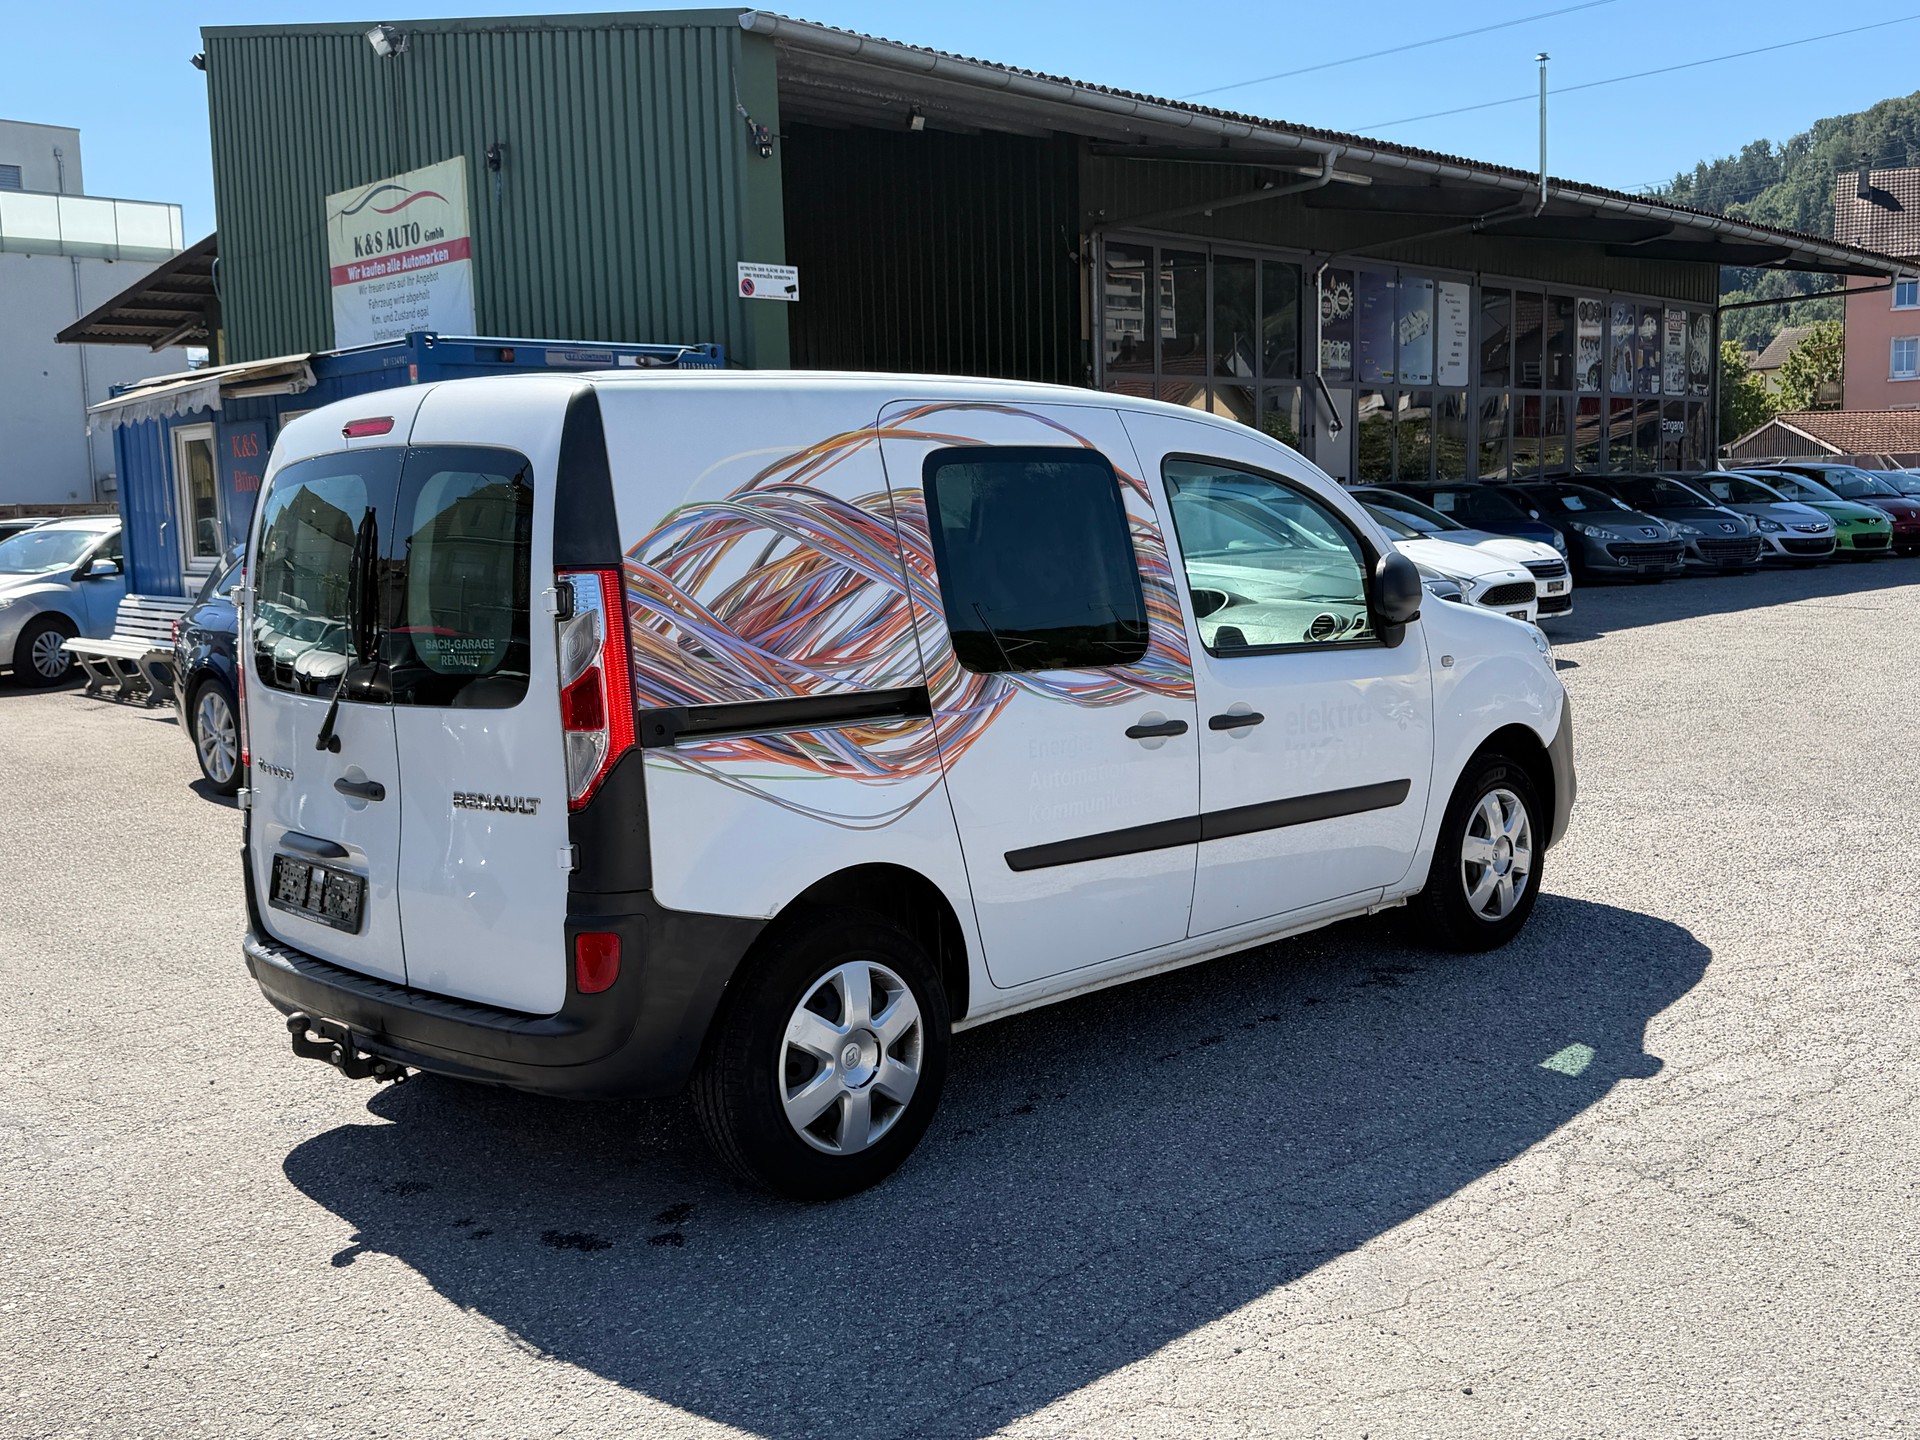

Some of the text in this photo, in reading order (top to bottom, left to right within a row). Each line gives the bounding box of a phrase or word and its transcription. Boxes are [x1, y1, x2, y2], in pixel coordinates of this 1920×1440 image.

[354, 231, 383, 258] K&S
[386, 221, 420, 250] AUTO
[347, 249, 449, 281] Wir kaufen alle Automarken
[358, 271, 439, 296] Wir freuen uns auf Ihr Angebot
[368, 290, 431, 311] Fahrzeug wird abgeholt
[371, 305, 429, 325] Km. und Zustand egal
[1661, 418, 1684, 434] Eingang
[232, 433, 258, 458] K&S
[234, 470, 260, 493] Büro
[425, 638, 495, 650] BACH-GARAGE
[441, 655, 481, 666] RENAULT
[453, 790, 541, 815] RENAULT
